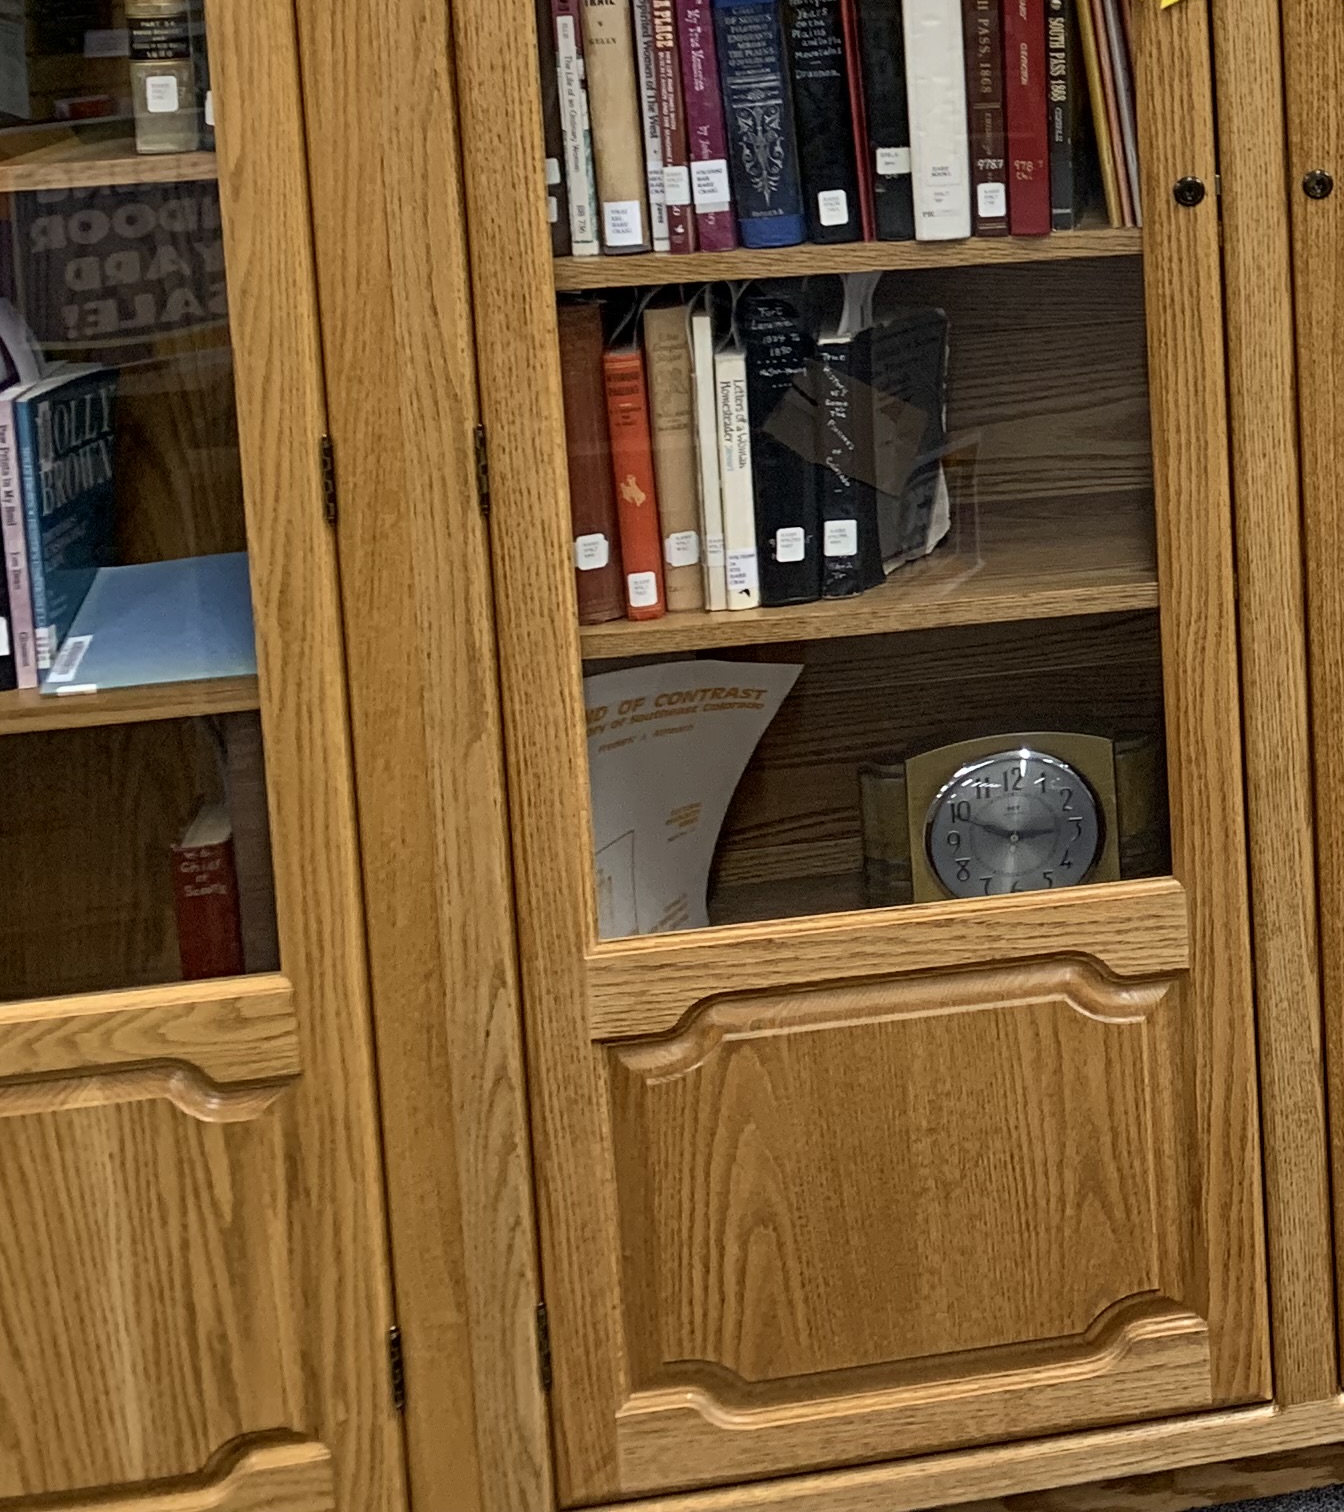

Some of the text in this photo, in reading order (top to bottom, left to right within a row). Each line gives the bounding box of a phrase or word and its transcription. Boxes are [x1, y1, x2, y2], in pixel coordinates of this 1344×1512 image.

[654, 10, 673, 48] PLACE
[977, 18, 991, 57] PASS,
[642, 41, 655, 79] Women
[1048, 17, 1066, 102] SOUTH PASS 1868
[733, 380, 746, 412] Letters
[720, 381, 734, 442] Homesteader
[40, 437, 115, 517] BROWN
[618, 687, 768, 715] OF CONTRAST
[1002, 767, 1022, 792] 12
[950, 800, 970, 824] 10
[1060, 788, 1073, 812] 2
[947, 830, 961, 854] 9
[1068, 816, 1082, 842] 3
[954, 858, 970, 882] 8
